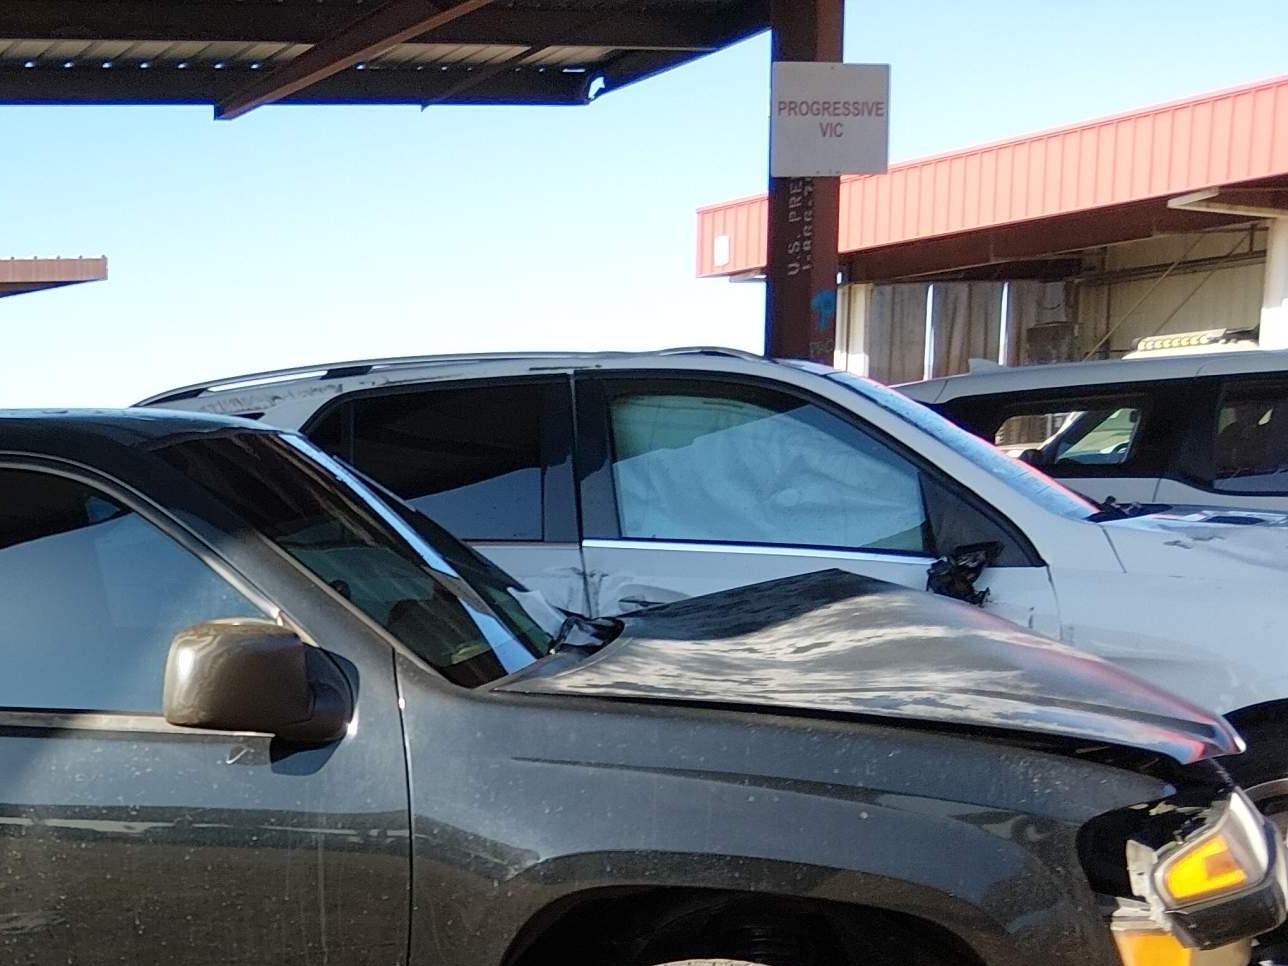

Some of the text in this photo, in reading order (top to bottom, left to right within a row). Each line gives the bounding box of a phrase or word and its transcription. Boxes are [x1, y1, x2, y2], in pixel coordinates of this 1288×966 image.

[778, 101, 885, 117] PROGRESSIVE
[819, 123, 844, 138] VIC
[787, 177, 803, 222] PRE
